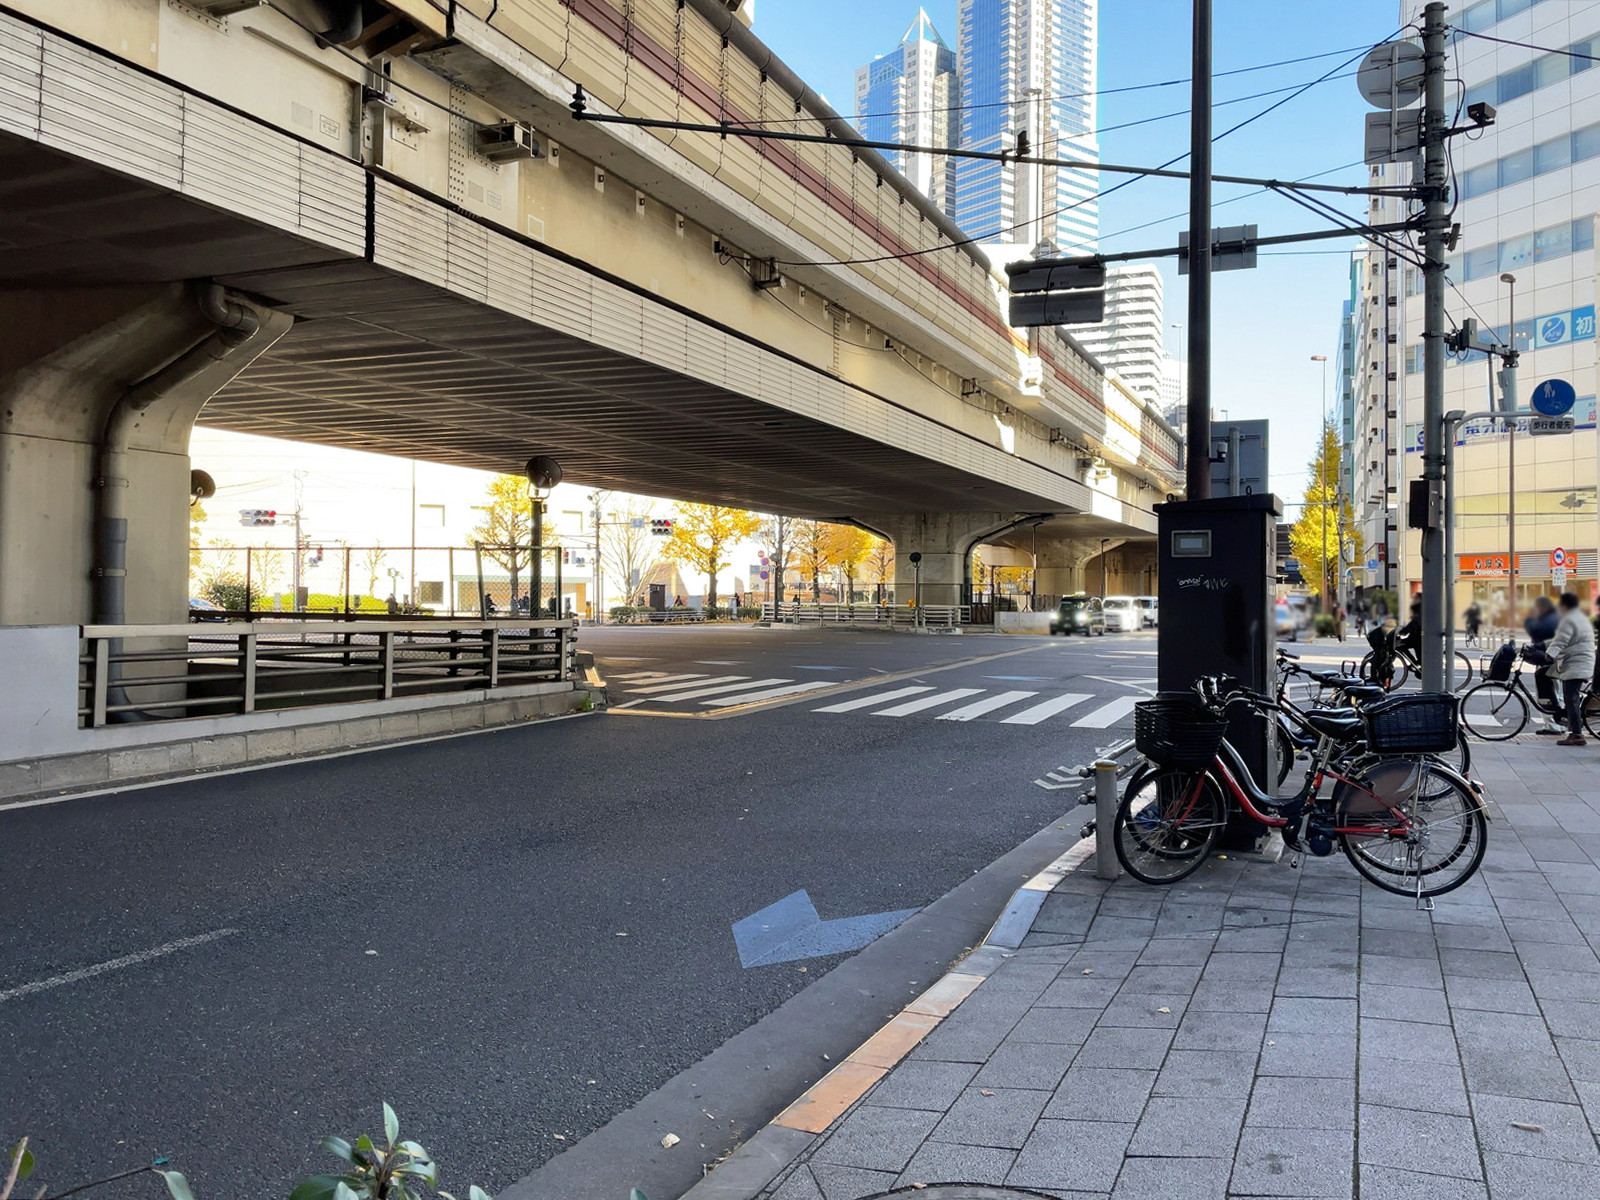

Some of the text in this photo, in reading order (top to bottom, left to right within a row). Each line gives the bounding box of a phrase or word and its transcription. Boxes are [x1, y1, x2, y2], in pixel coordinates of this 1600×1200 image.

[1575, 315, 1593, 336] 初
[1533, 420, 1572, 430] 歩行者優先
